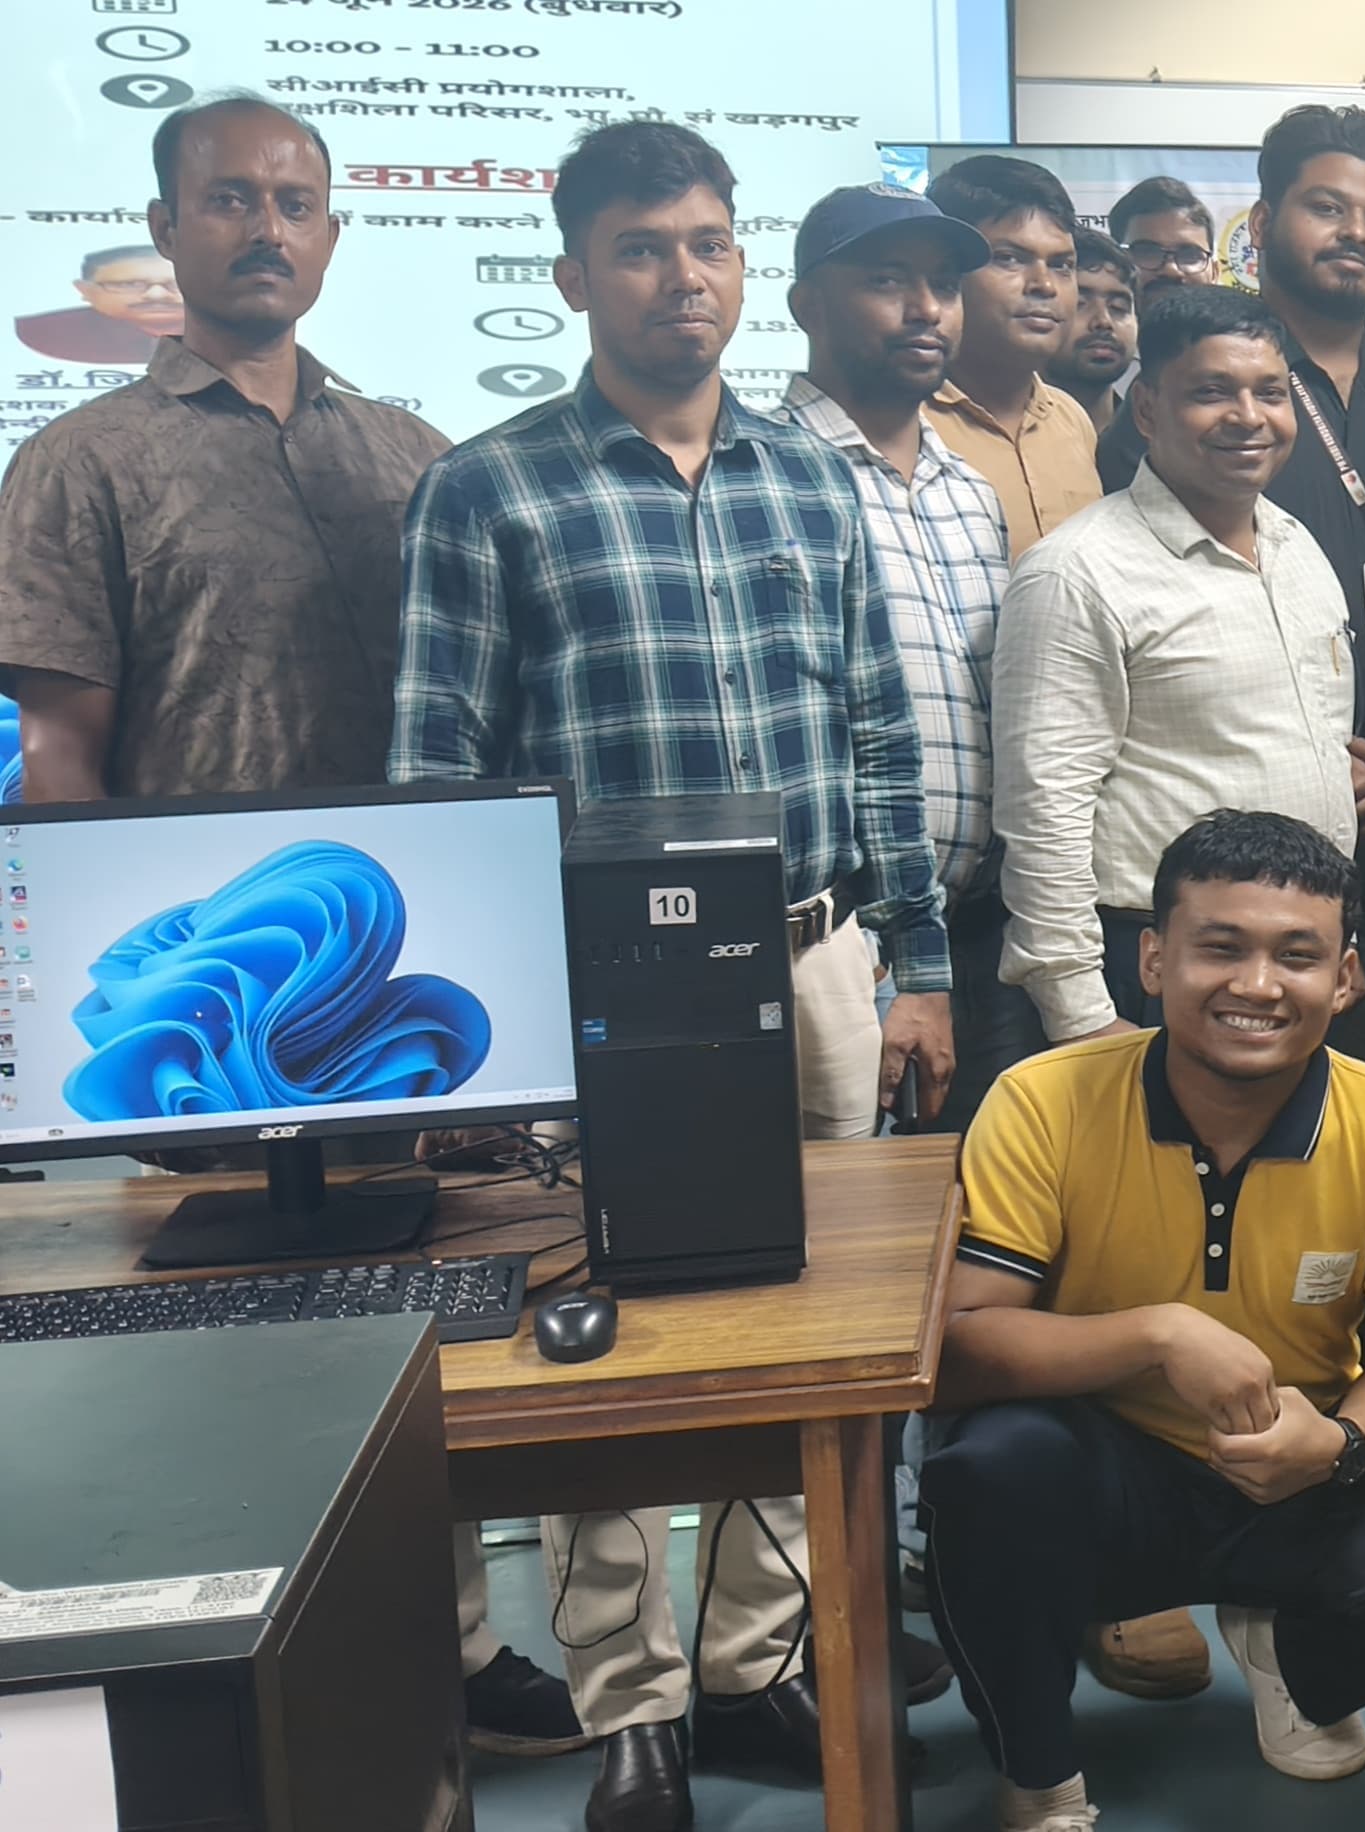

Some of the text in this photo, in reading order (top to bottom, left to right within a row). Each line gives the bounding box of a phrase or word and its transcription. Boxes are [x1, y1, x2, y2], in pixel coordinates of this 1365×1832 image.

[264, 39, 382, 55] 10:00
[425, 41, 541, 59] 11:00
[265, 76, 636, 101] सीआईसी प्रयोगशाला,
[427, 101, 554, 121] परिसर,
[723, 111, 862, 131] खड़गपुर
[362, 214, 447, 228] काम
[455, 212, 545, 229] करने
[655, 894, 691, 918] 10
[708, 941, 762, 959] acer
[257, 1124, 304, 1141] acer
